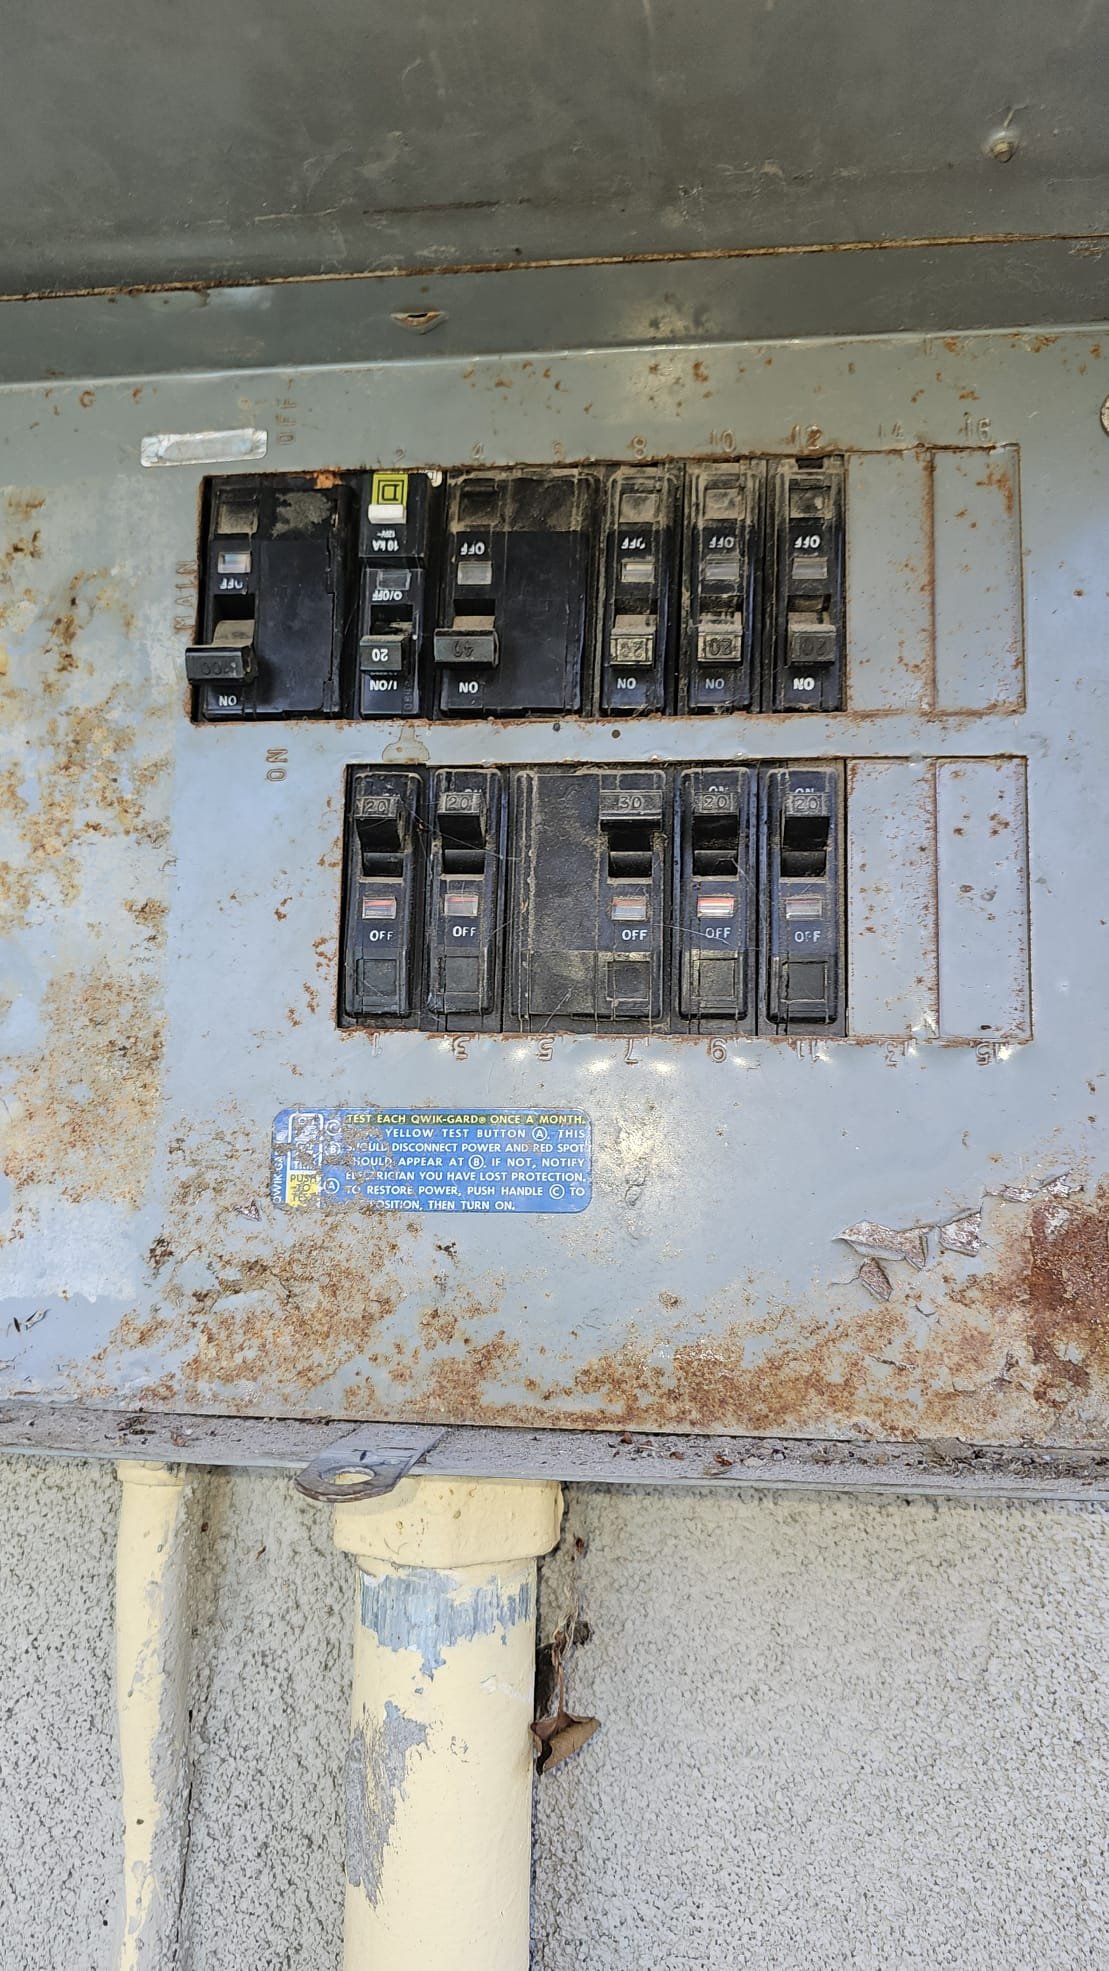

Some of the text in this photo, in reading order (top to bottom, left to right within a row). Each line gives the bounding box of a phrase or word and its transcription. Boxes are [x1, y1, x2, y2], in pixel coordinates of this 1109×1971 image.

[960, 417, 992, 442] 16
[708, 429, 736, 452] 10
[786, 423, 825, 450] 12
[631, 433, 648, 459] 8
[708, 535, 736, 549] OFF
[793, 534, 821, 549] OFF
[460, 542, 486, 555] OFF
[371, 648, 389, 662] 20
[369, 680, 398, 691] I/ON
[458, 681, 479, 694] ON
[616, 677, 637, 690] ON
[705, 678, 725, 691] ON
[792, 677, 815, 691] ON
[218, 695, 237, 707] ON
[265, 747, 289, 783] ON
[364, 800, 389, 814] 20
[447, 796, 471, 810] 20
[702, 793, 729, 810] 20
[794, 795, 820, 812] 20
[369, 929, 394, 942] OFF
[452, 925, 477, 938] OFF
[621, 929, 648, 942] OFF
[705, 927, 732, 939] OFF
[794, 930, 822, 943] OFF
[347, 1114, 372, 1124] TEST
[377, 1114, 406, 1124] EACH
[490, 1115, 521, 1124] ONCE
[526, 1115, 534, 1124] A
[540, 1115, 586, 1124] MONTH.
[385, 1128, 434, 1139] YELLOW
[442, 1128, 469, 1139] TEST
[477, 1129, 526, 1139] BUTTON
[558, 1129, 585, 1139] THIS
[391, 1142, 458, 1153] DISCONNECT
[461, 1143, 502, 1153] POWER
[505, 1143, 529, 1153] AND
[532, 1143, 553, 1153] RED
[557, 1143, 585, 1153] SPOT
[397, 1157, 443, 1167] APPEAR
[448, 1157, 464, 1167] AT
[491, 1157, 502, 1167] IF
[507, 1157, 537, 1169] NOT,
[541, 1157, 585, 1167] NOTIFY
[419, 1171, 443, 1181] YOU
[446, 1171, 477, 1181] HAVE
[479, 1171, 508, 1182] LOST
[511, 1172, 587, 1182] PROTECTION.
[367, 1185, 413, 1195] RESTORE
[418, 1186, 462, 1197] POWER,
[467, 1186, 495, 1196] PUSH
[501, 1187, 543, 1196] HANDLE
[569, 1187, 585, 1197] TO
[369, 1199, 423, 1211] OSITION,
[427, 1200, 455, 1210] THEN
[460, 1200, 490, 1210] TURN
[494, 1201, 516, 1211] ON.
